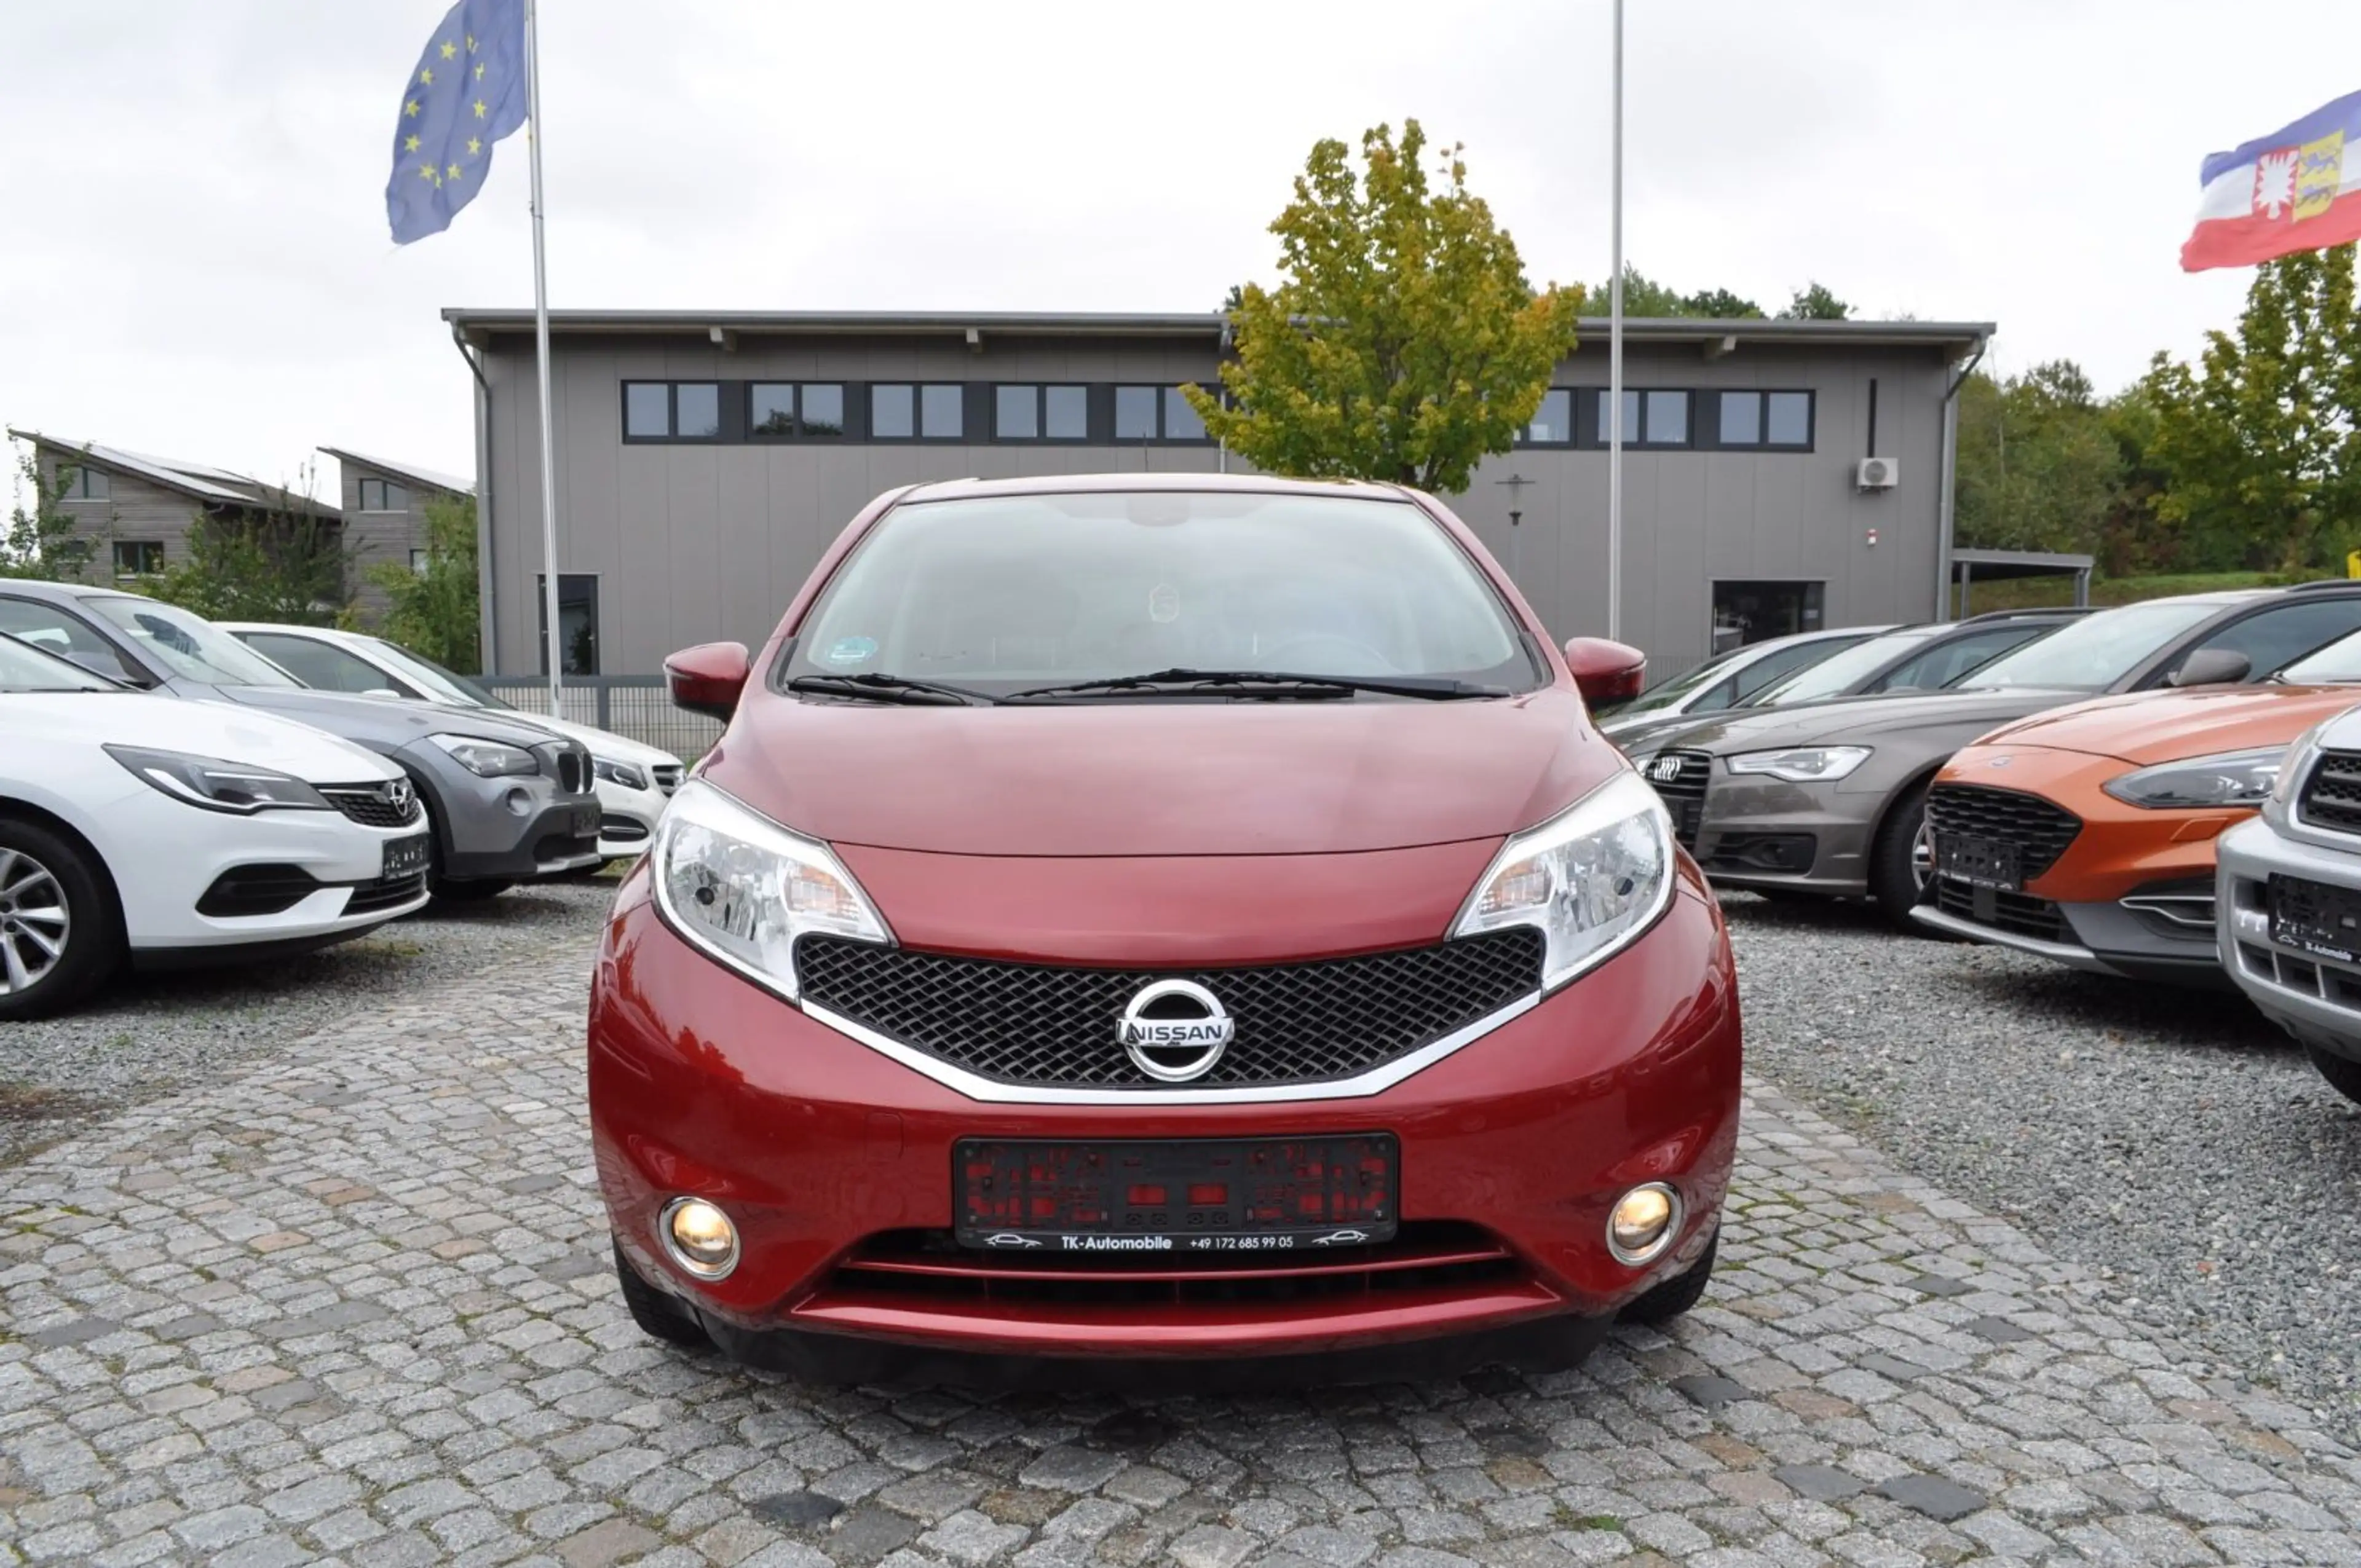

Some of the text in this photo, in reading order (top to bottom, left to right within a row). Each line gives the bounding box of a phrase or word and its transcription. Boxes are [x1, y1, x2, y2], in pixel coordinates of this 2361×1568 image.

[1129, 1025, 1222, 1041] NISSAN
[1062, 1236, 1293, 1249] TK-Automobile +49 172 685 99 05
